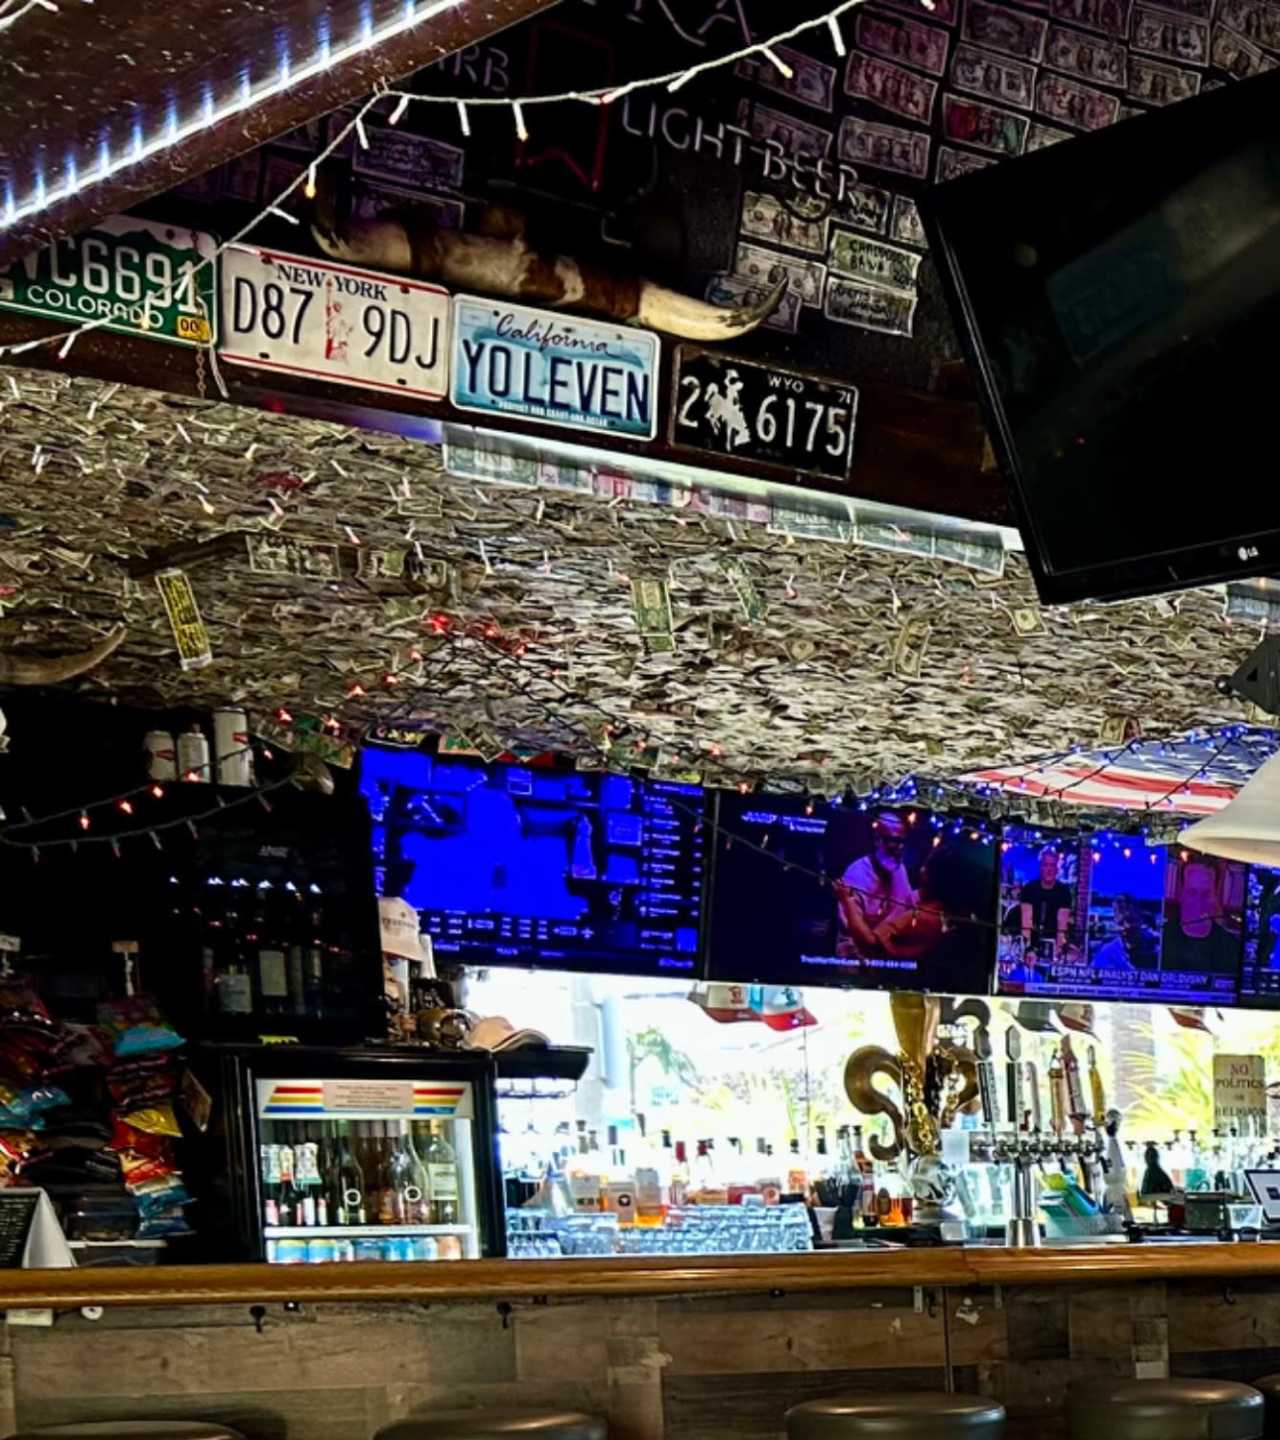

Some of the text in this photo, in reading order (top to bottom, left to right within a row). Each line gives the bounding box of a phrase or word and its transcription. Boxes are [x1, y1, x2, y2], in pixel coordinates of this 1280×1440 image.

[622, 97, 858, 203] LIGHT BEER
[276, 264, 387, 302] NEW YORK
[26, 284, 165, 330] COLORADO
[232, 276, 440, 370] D87 9DJ
[497, 313, 614, 357] California
[768, 373, 805, 393] WYO
[679, 376, 847, 457] 2 6175
[1231, 1063, 1249, 1076] NO
